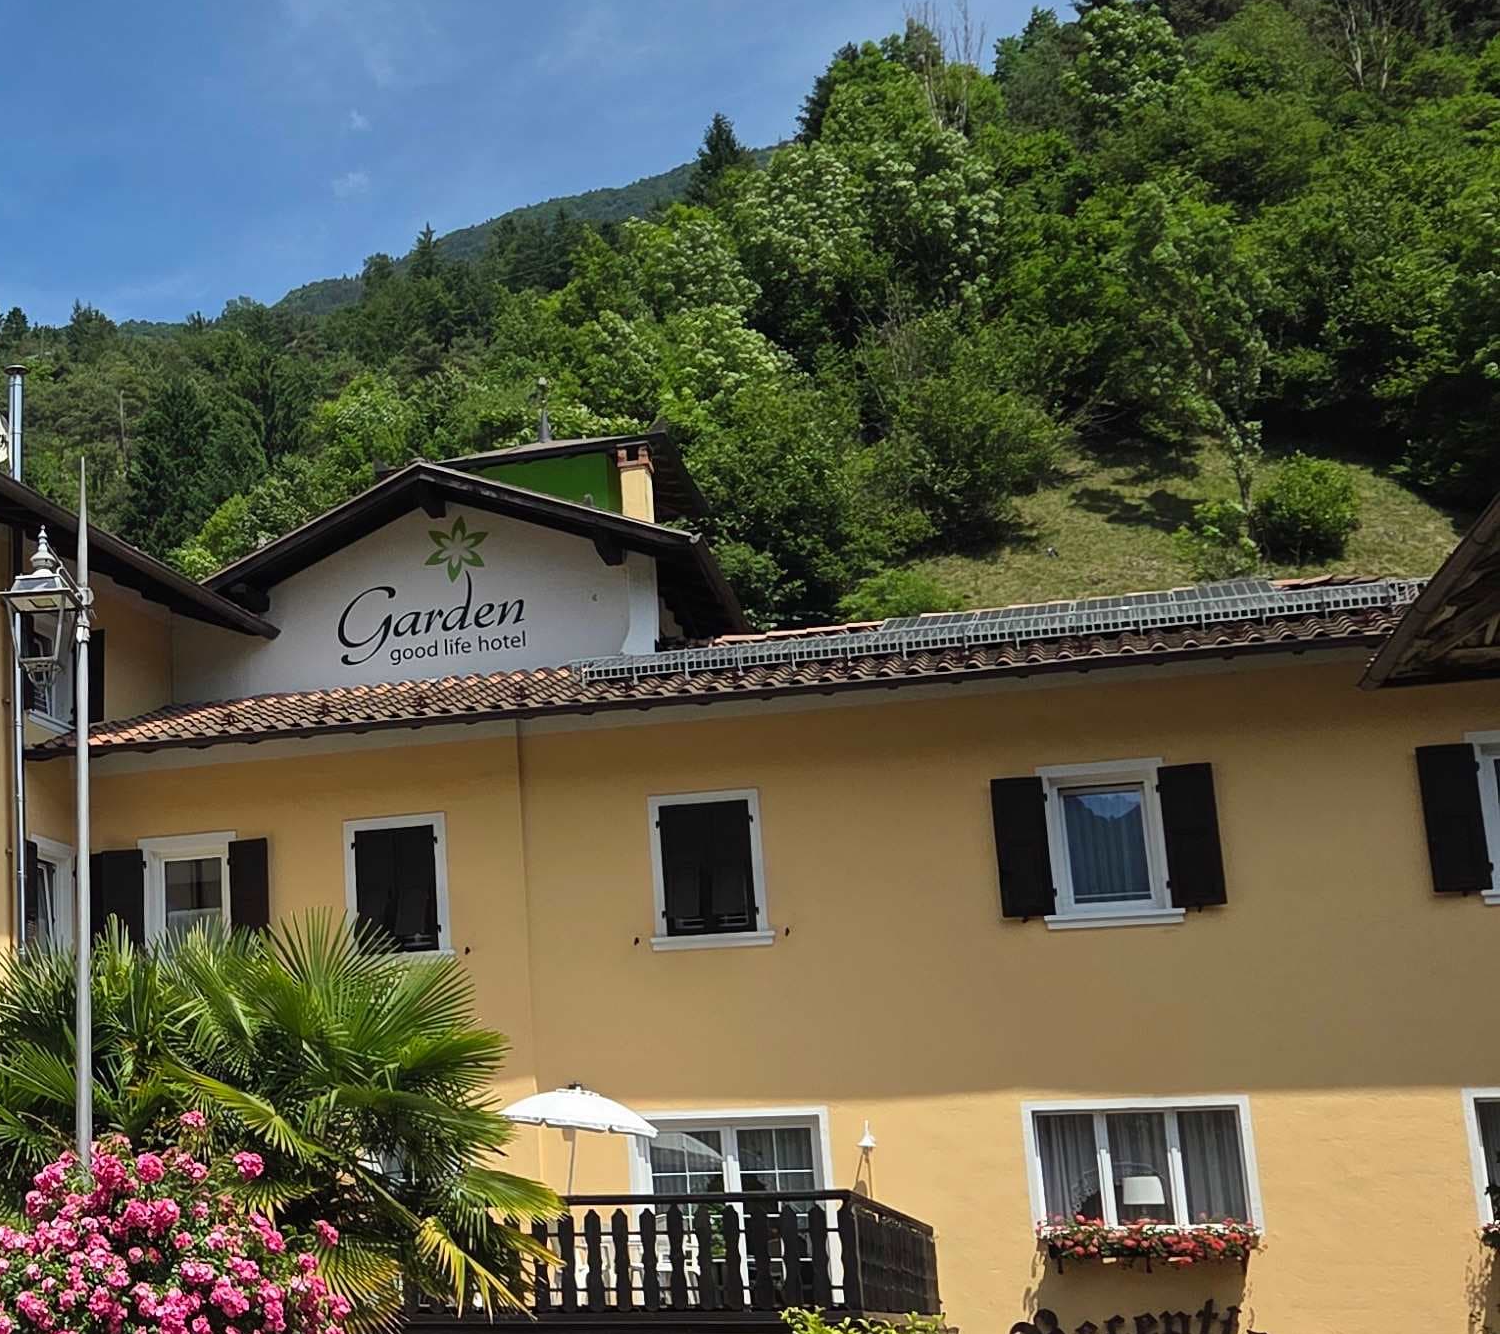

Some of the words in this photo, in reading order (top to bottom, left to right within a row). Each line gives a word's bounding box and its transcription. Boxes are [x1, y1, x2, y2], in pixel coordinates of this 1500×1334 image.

[337, 570, 525, 666] Garden
[390, 640, 438, 666] good
[444, 636, 472, 656] life
[478, 630, 526, 652] hotel
